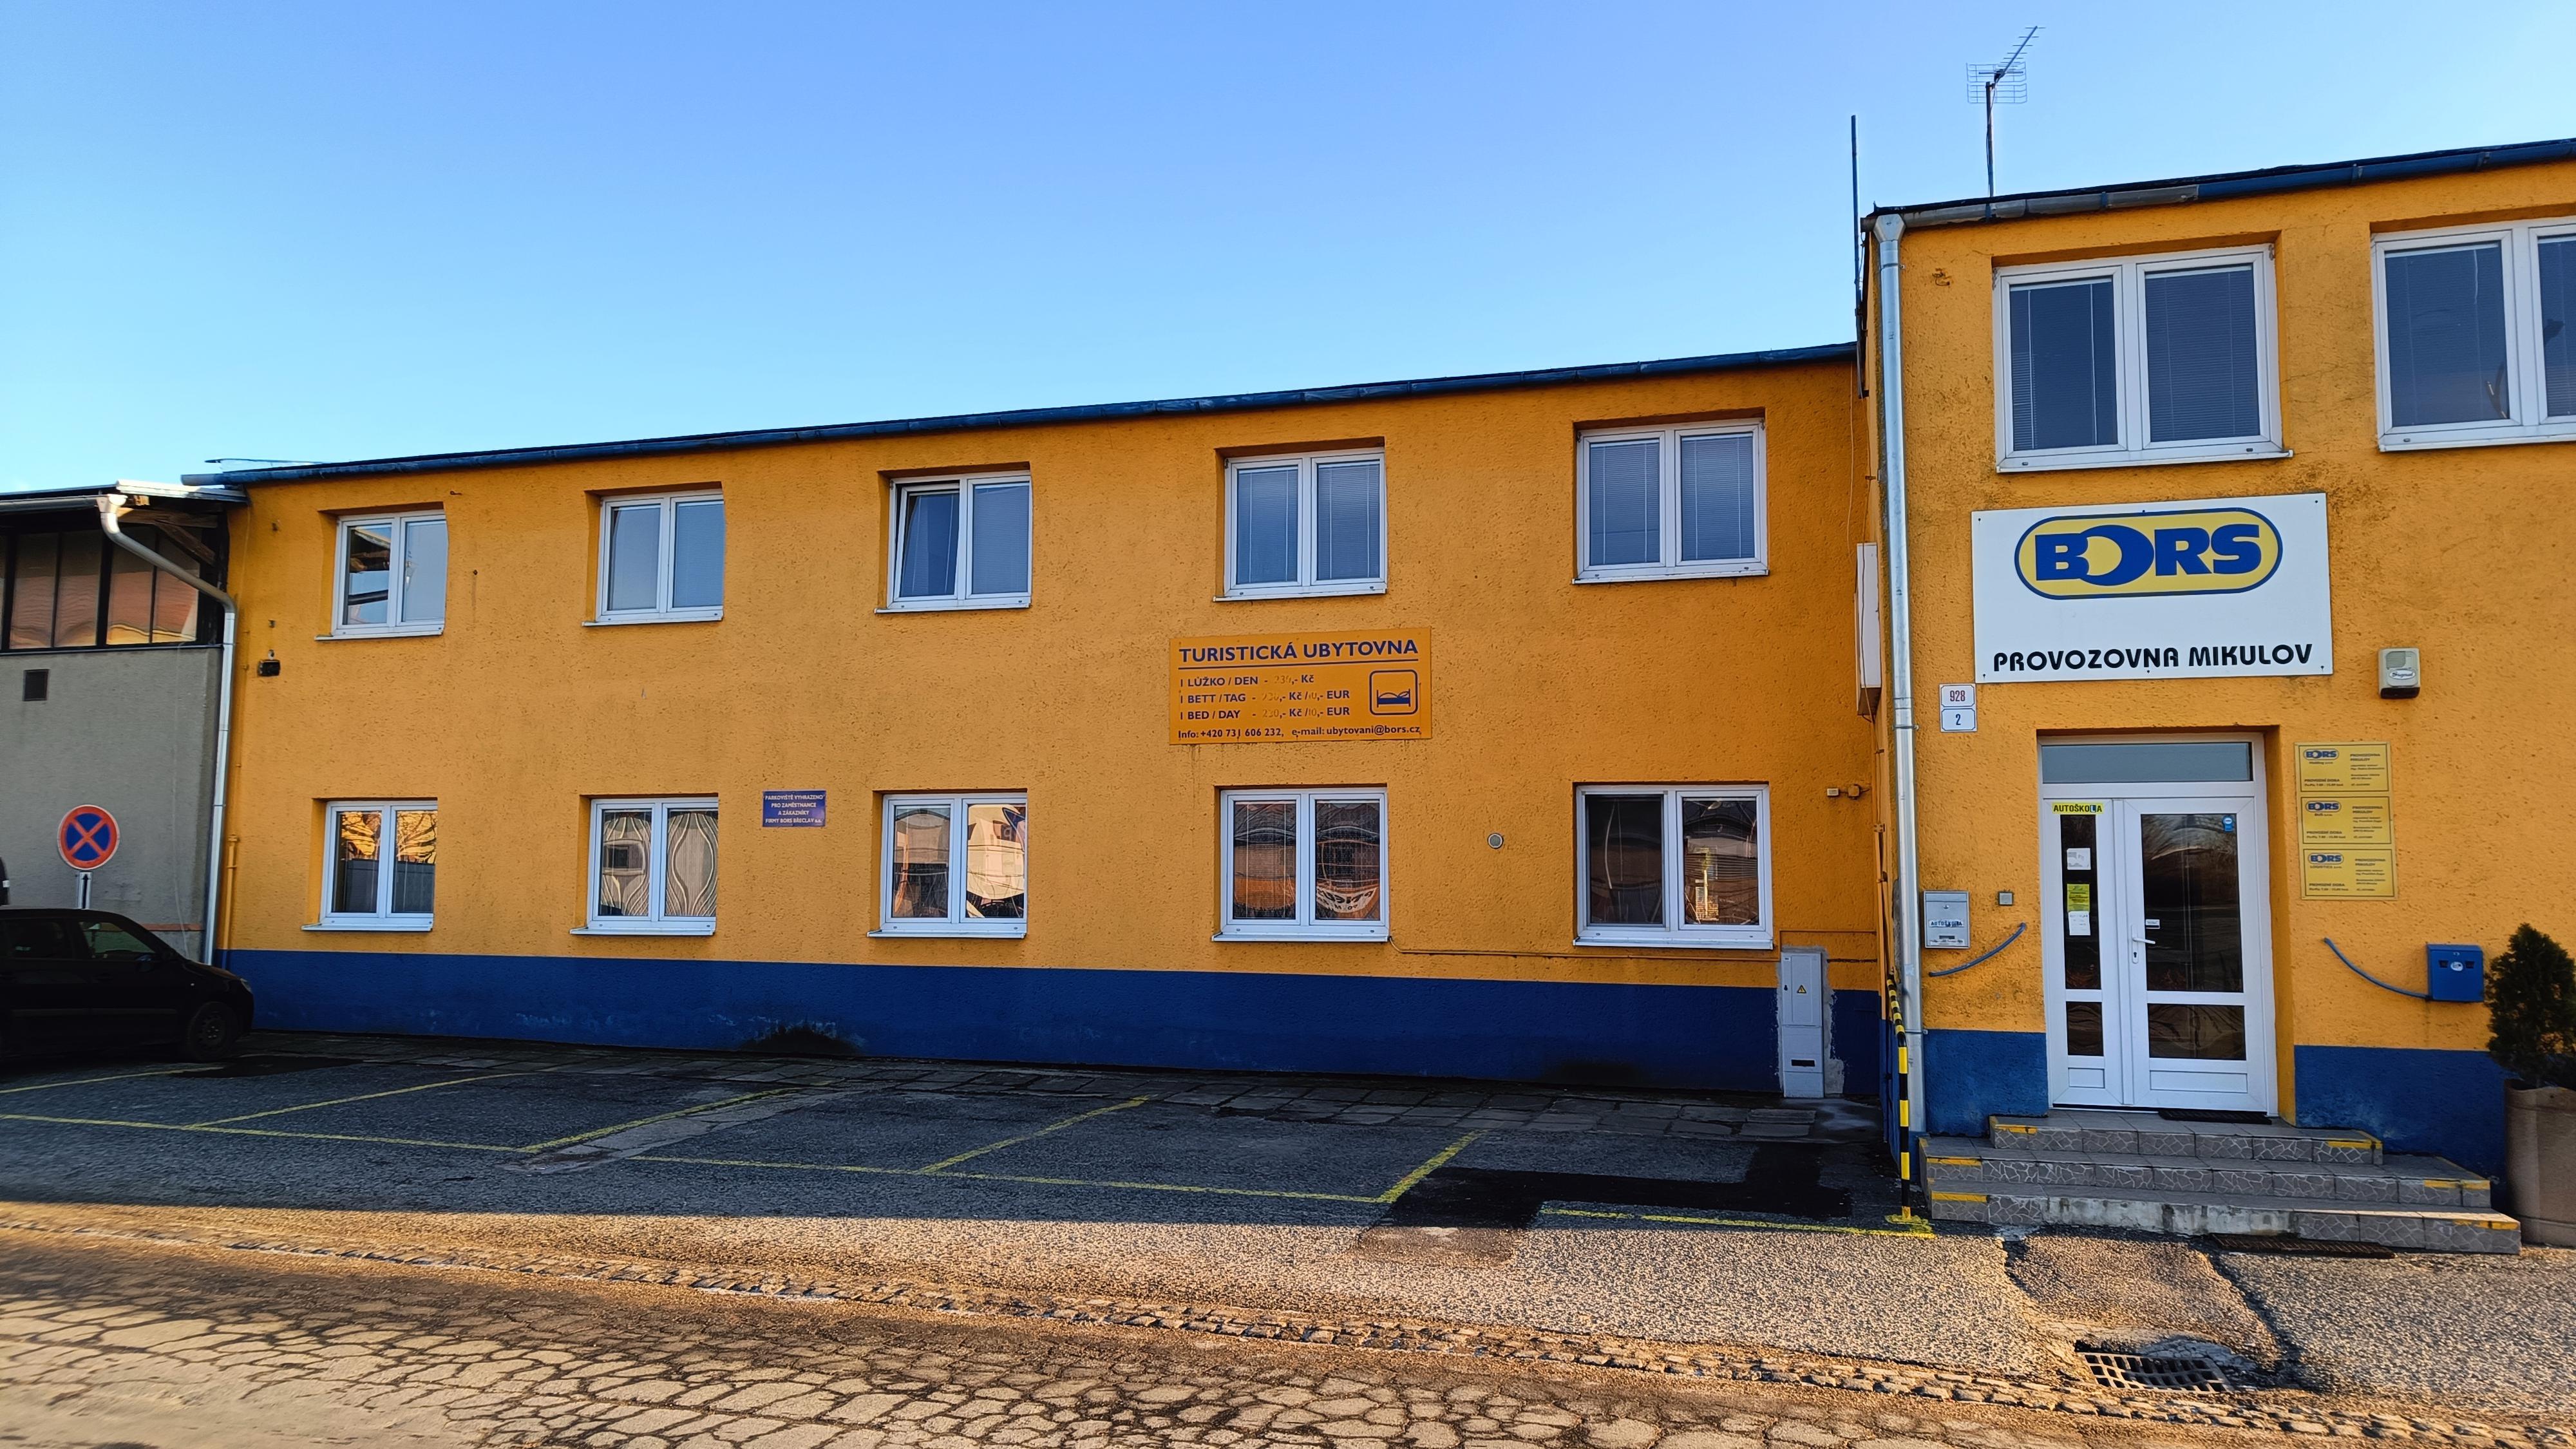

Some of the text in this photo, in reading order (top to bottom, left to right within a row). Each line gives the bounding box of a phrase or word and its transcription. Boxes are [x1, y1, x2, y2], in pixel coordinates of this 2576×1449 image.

[2034, 523, 2262, 587] BORS
[1179, 639, 1418, 663] TURISTICKÁ UBYTOVNA
[1993, 643, 2313, 672] PROVOZOVNA MIKULOV
[1188, 676, 1226, 687] LŮŽKO
[1235, 676, 1258, 685] DEN
[1301, 674, 1314, 683] Kč
[1188, 694, 1217, 703] BETT
[1224, 693, 1246, 703] TAG
[1289, 692, 1302, 701] Kč
[1327, 690, 1350, 699] EUR
[1949, 690, 1965, 702] 928
[1188, 711, 1209, 720] BED
[1218, 710, 1241, 719] DAY
[1289, 708, 1302, 717] Kč
[1327, 707, 1350, 716] EUR
[1955, 714, 1961, 725] 2
[1226, 728, 1241, 737] 731
[1245, 728, 1262, 737] 606
[2306, 750, 2337, 759] BORS
[2053, 803, 2103, 813] AUTOŠKOLA
[2308, 802, 2339, 811] BORS
